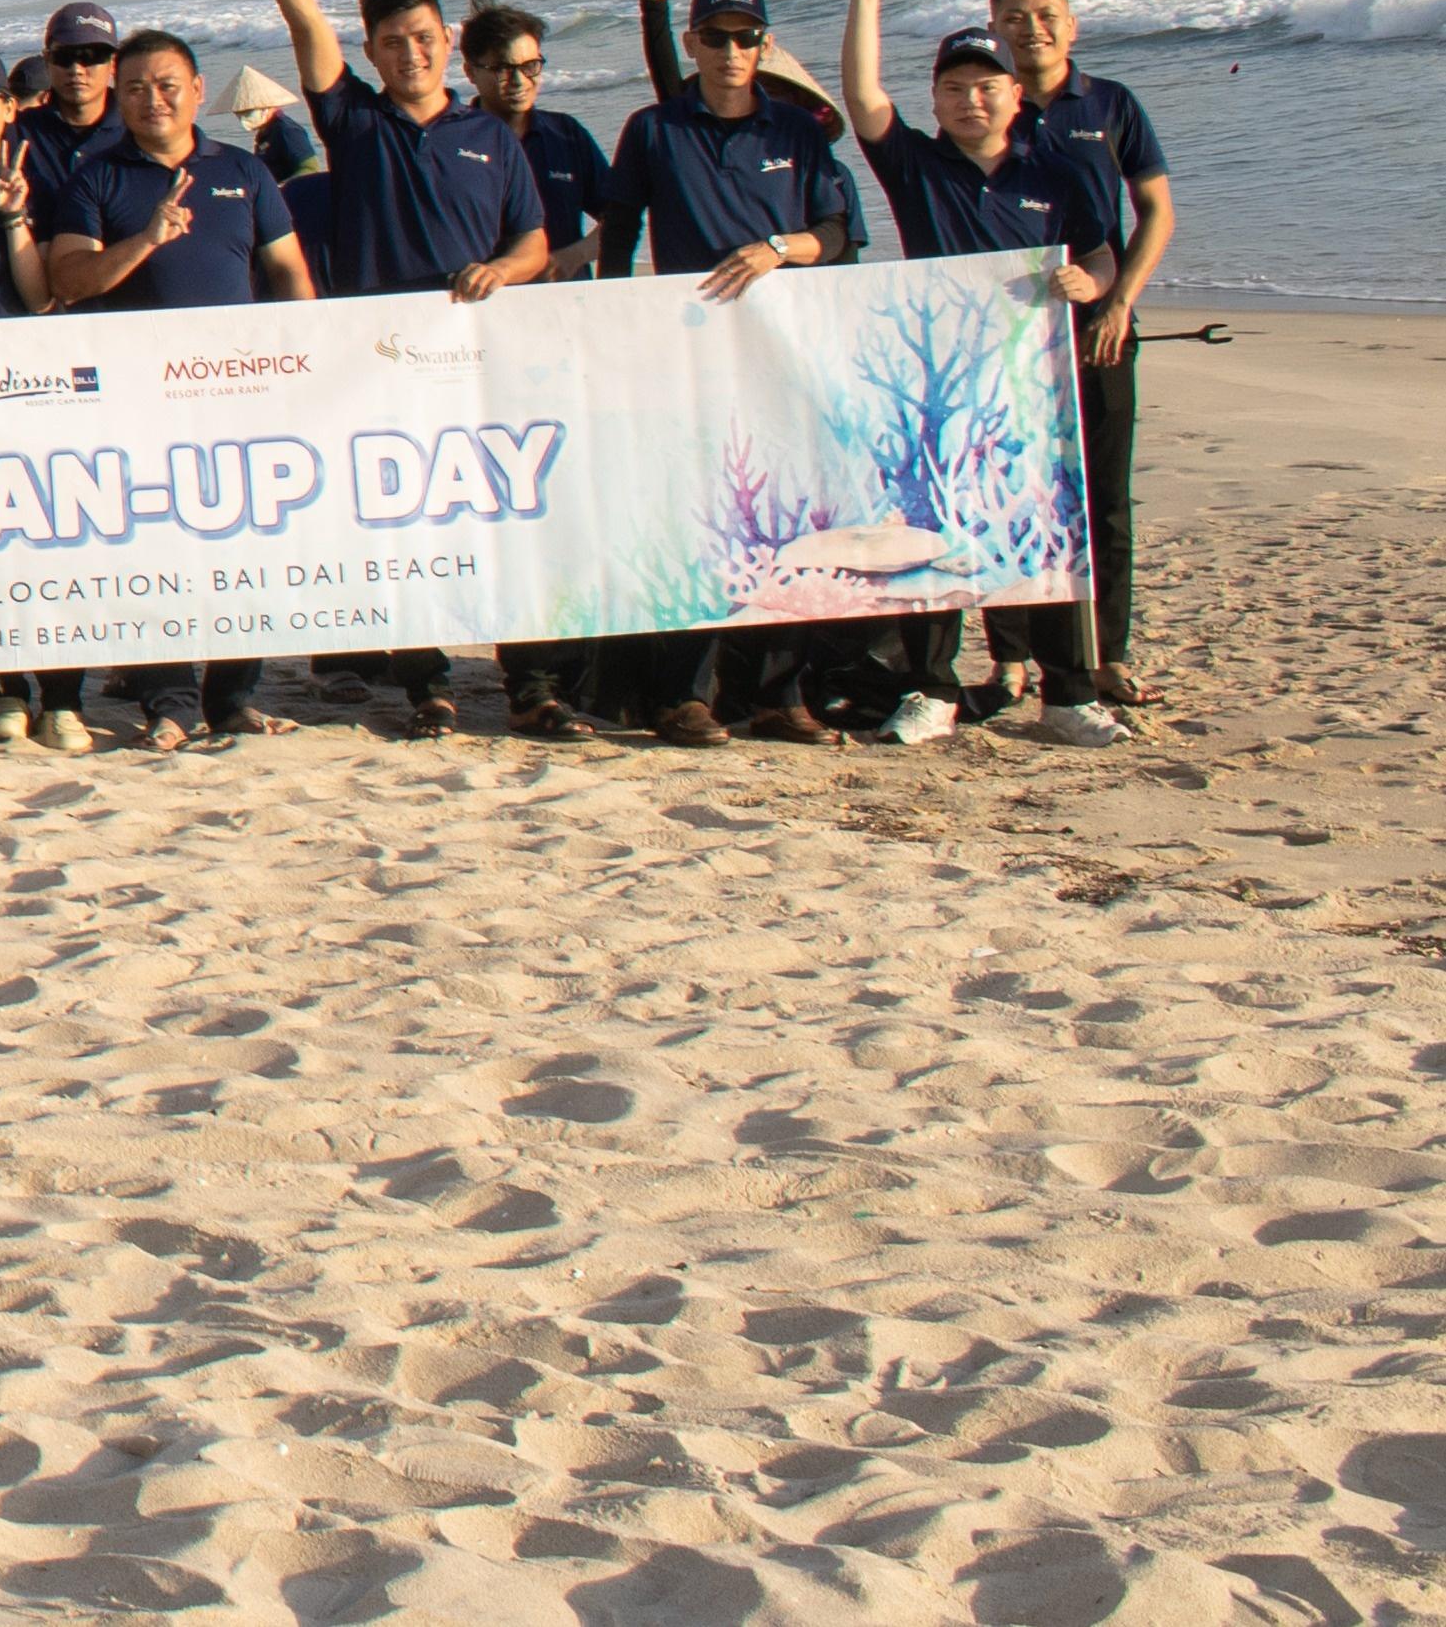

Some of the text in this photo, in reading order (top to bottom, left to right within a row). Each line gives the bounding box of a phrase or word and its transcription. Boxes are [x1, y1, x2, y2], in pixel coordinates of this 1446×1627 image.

[163, 354, 313, 382] MÖVENPICK
[404, 344, 487, 364] Swandor
[165, 389, 206, 399] RESORT
[351, 420, 567, 529] DAY
[214, 567, 266, 592] BAI
[287, 563, 344, 586] DAI
[365, 554, 476, 581] BEACH
[37, 621, 147, 646] BEAUTY
[162, 618, 199, 639] OF
[214, 613, 274, 635] OUR
[289, 606, 390, 630] OCEAN
